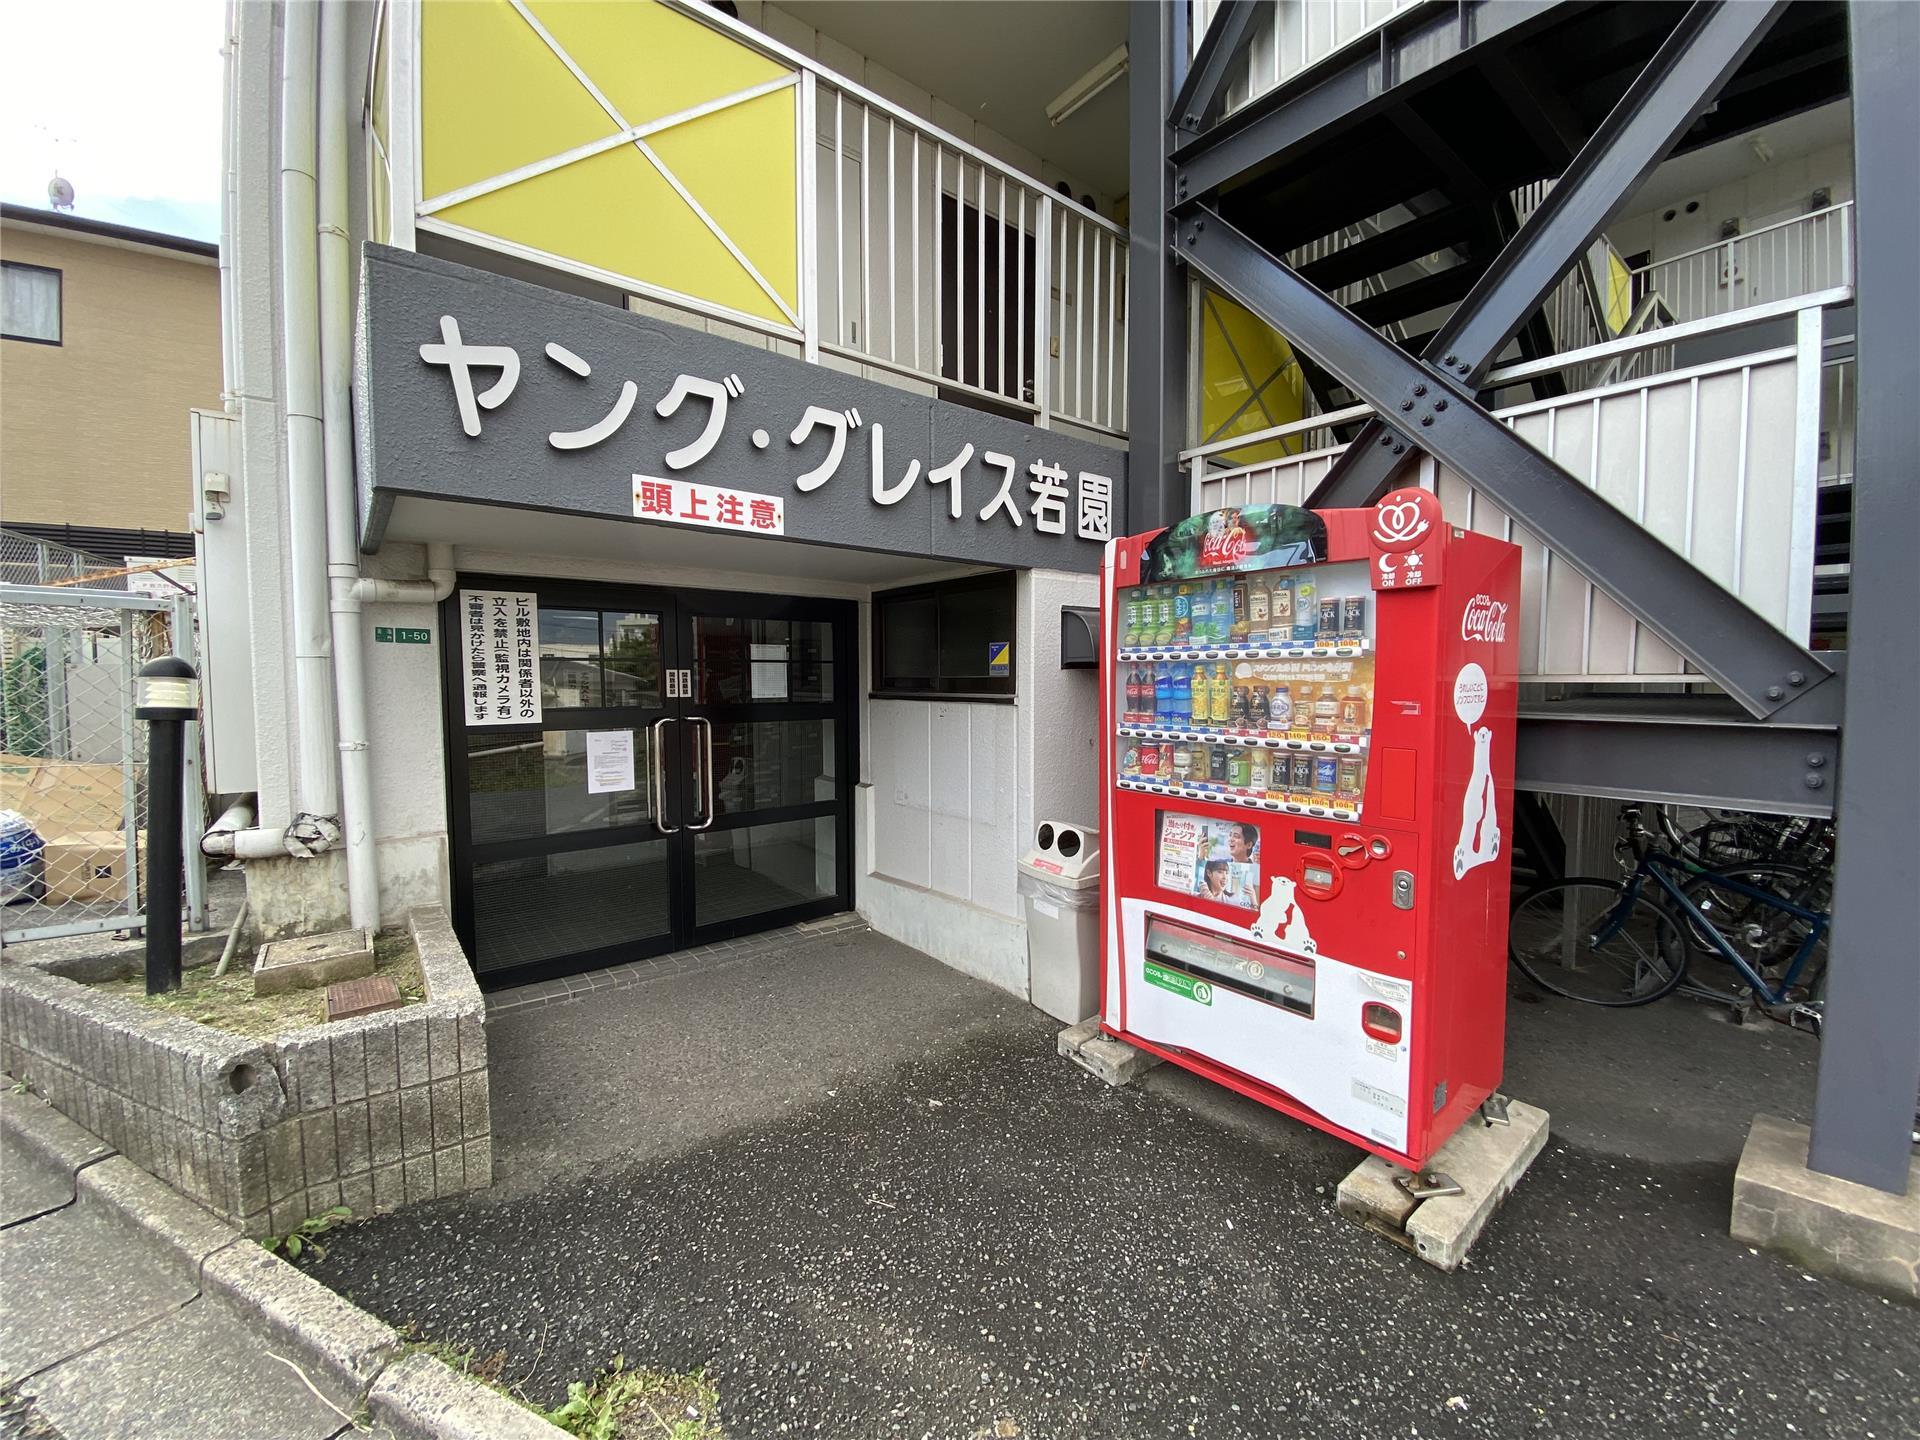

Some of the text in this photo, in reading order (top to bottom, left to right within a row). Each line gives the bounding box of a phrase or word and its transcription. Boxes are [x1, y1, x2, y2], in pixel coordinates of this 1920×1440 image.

[419, 315, 1113, 541] ヤング・グレイス若園
[640, 481, 777, 530] 頭上注意
[401, 631, 428, 640] 1-50
[1462, 597, 1508, 642] Coca-Cola
[516, 597, 534, 718] ビル敷地内は関係者以外の
